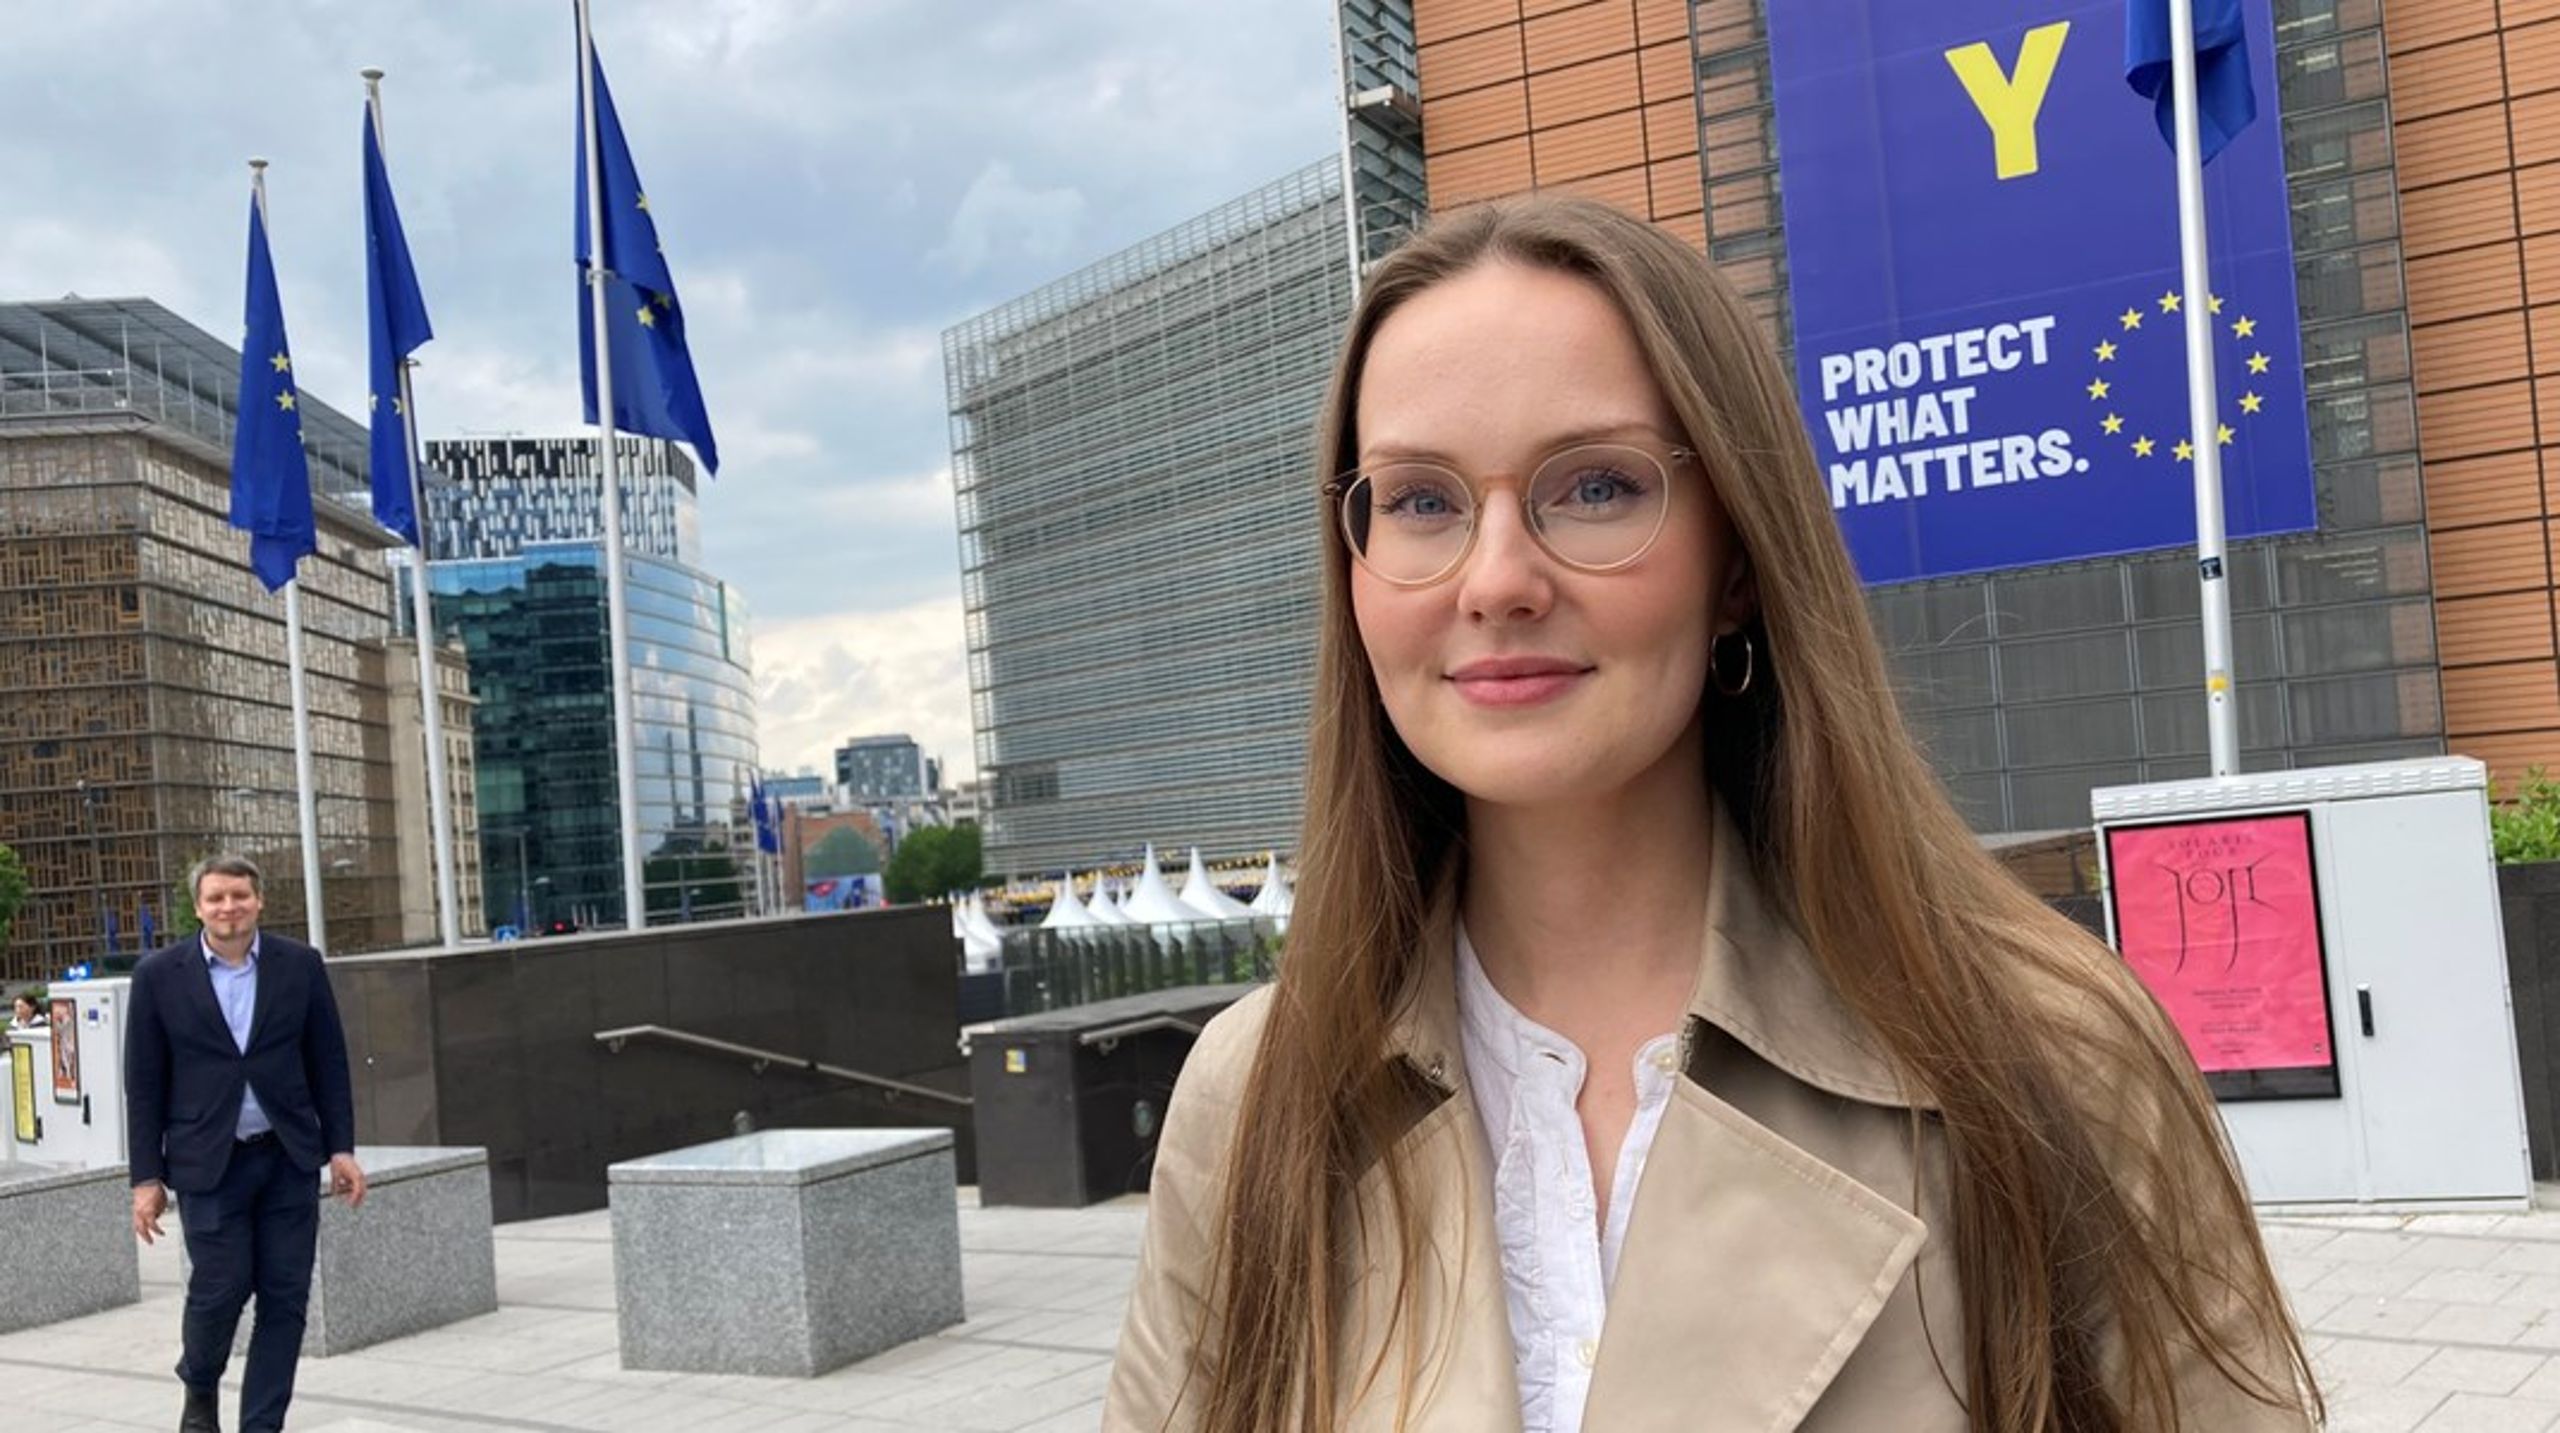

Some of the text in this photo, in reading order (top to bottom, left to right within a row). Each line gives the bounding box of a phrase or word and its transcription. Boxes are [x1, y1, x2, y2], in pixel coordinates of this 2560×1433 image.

[1944, 20, 2071, 180] Y
[1821, 315, 2055, 401] PROTECT
[1825, 386, 1976, 453] WHAT
[1830, 429, 2089, 508] MATTERS.
